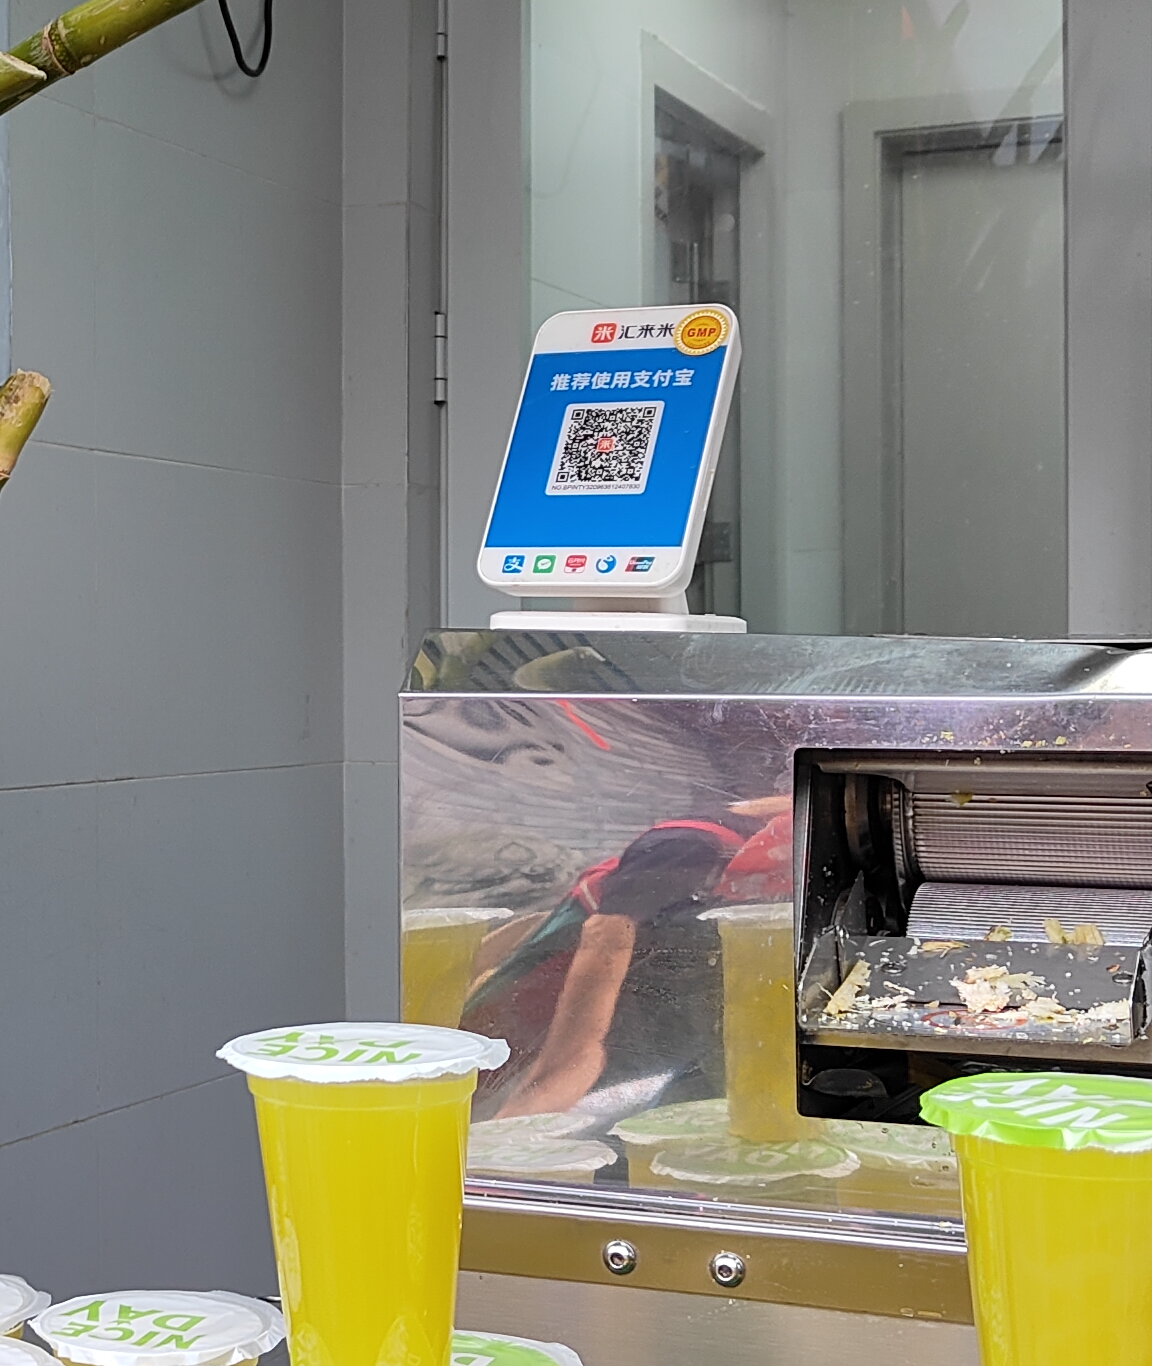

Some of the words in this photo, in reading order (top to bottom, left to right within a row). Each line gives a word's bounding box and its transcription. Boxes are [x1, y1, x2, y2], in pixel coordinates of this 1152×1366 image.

[687, 327, 716, 338] GMP
[550, 369, 694, 391] 推荐使用支付宝
[61, 1300, 208, 1332] DAY
[50, 1321, 207, 1350] NICE
